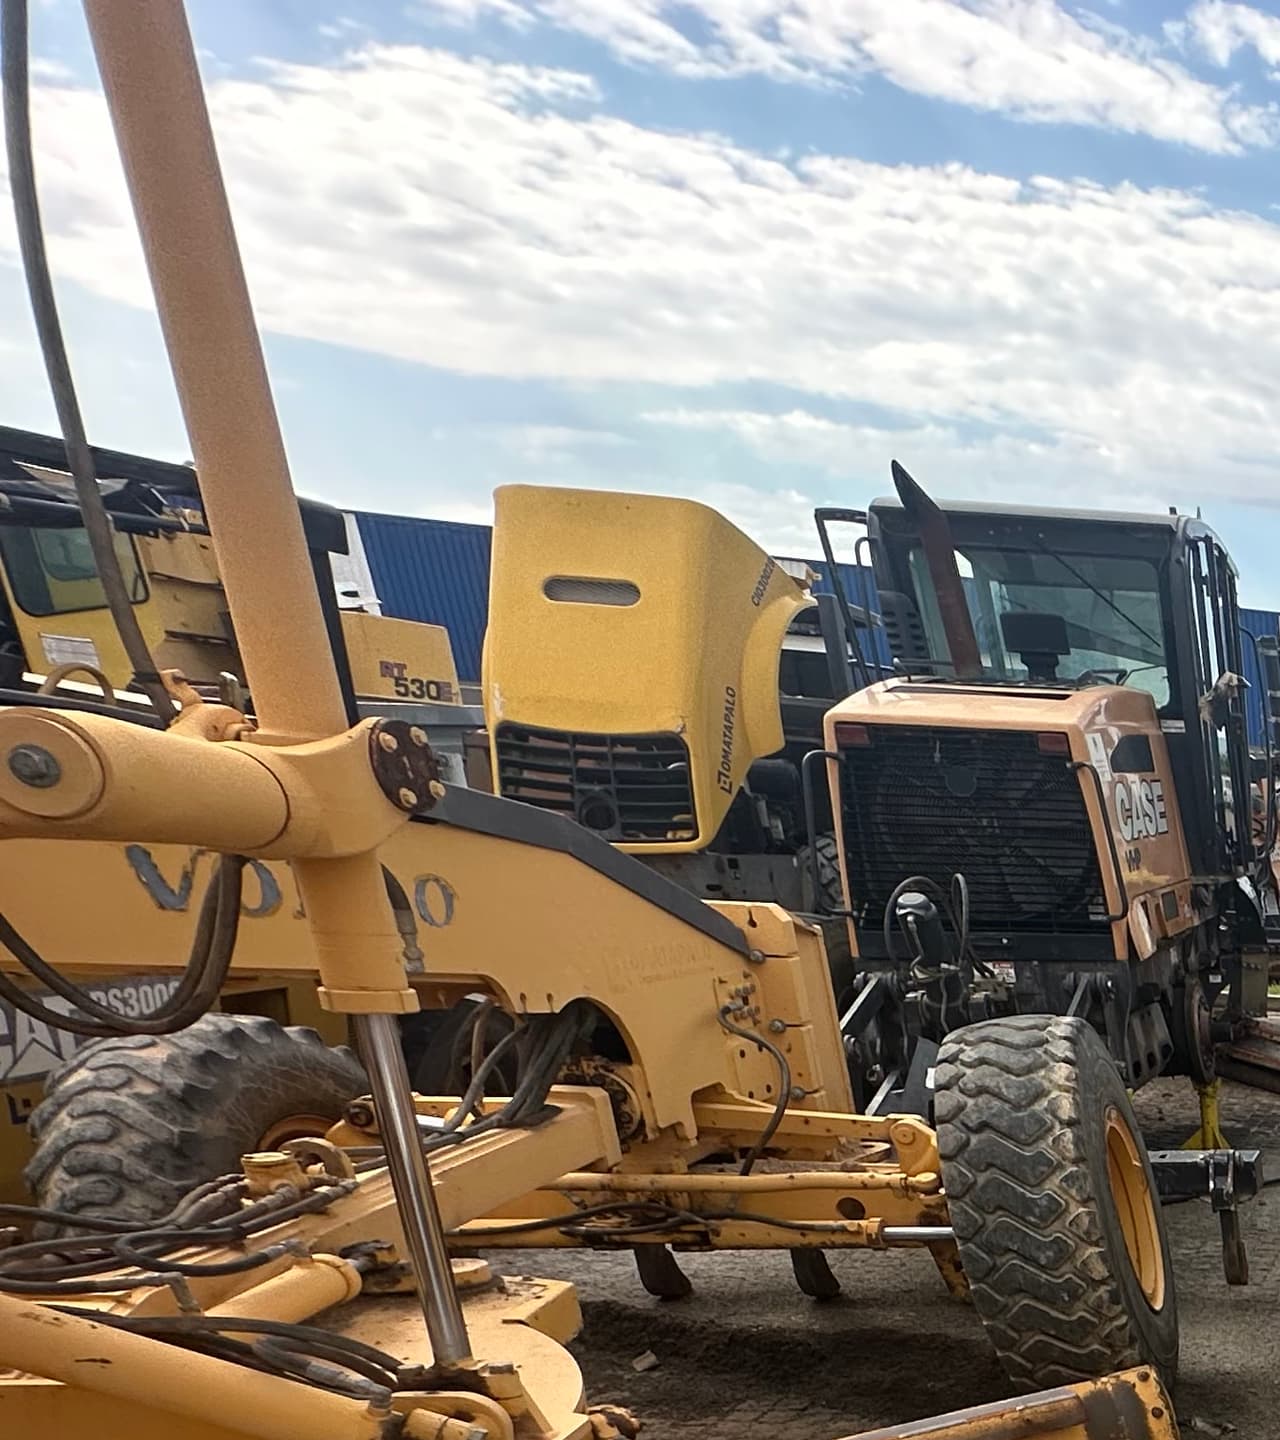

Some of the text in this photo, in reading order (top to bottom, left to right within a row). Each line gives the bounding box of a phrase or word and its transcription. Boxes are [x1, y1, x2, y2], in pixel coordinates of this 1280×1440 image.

[379, 660, 407, 679] RT
[395, 676, 453, 703] 530E
[722, 686, 737, 771] OMATAPALO
[1113, 778, 1169, 844] CASE
[125, 843, 457, 929] VOO
